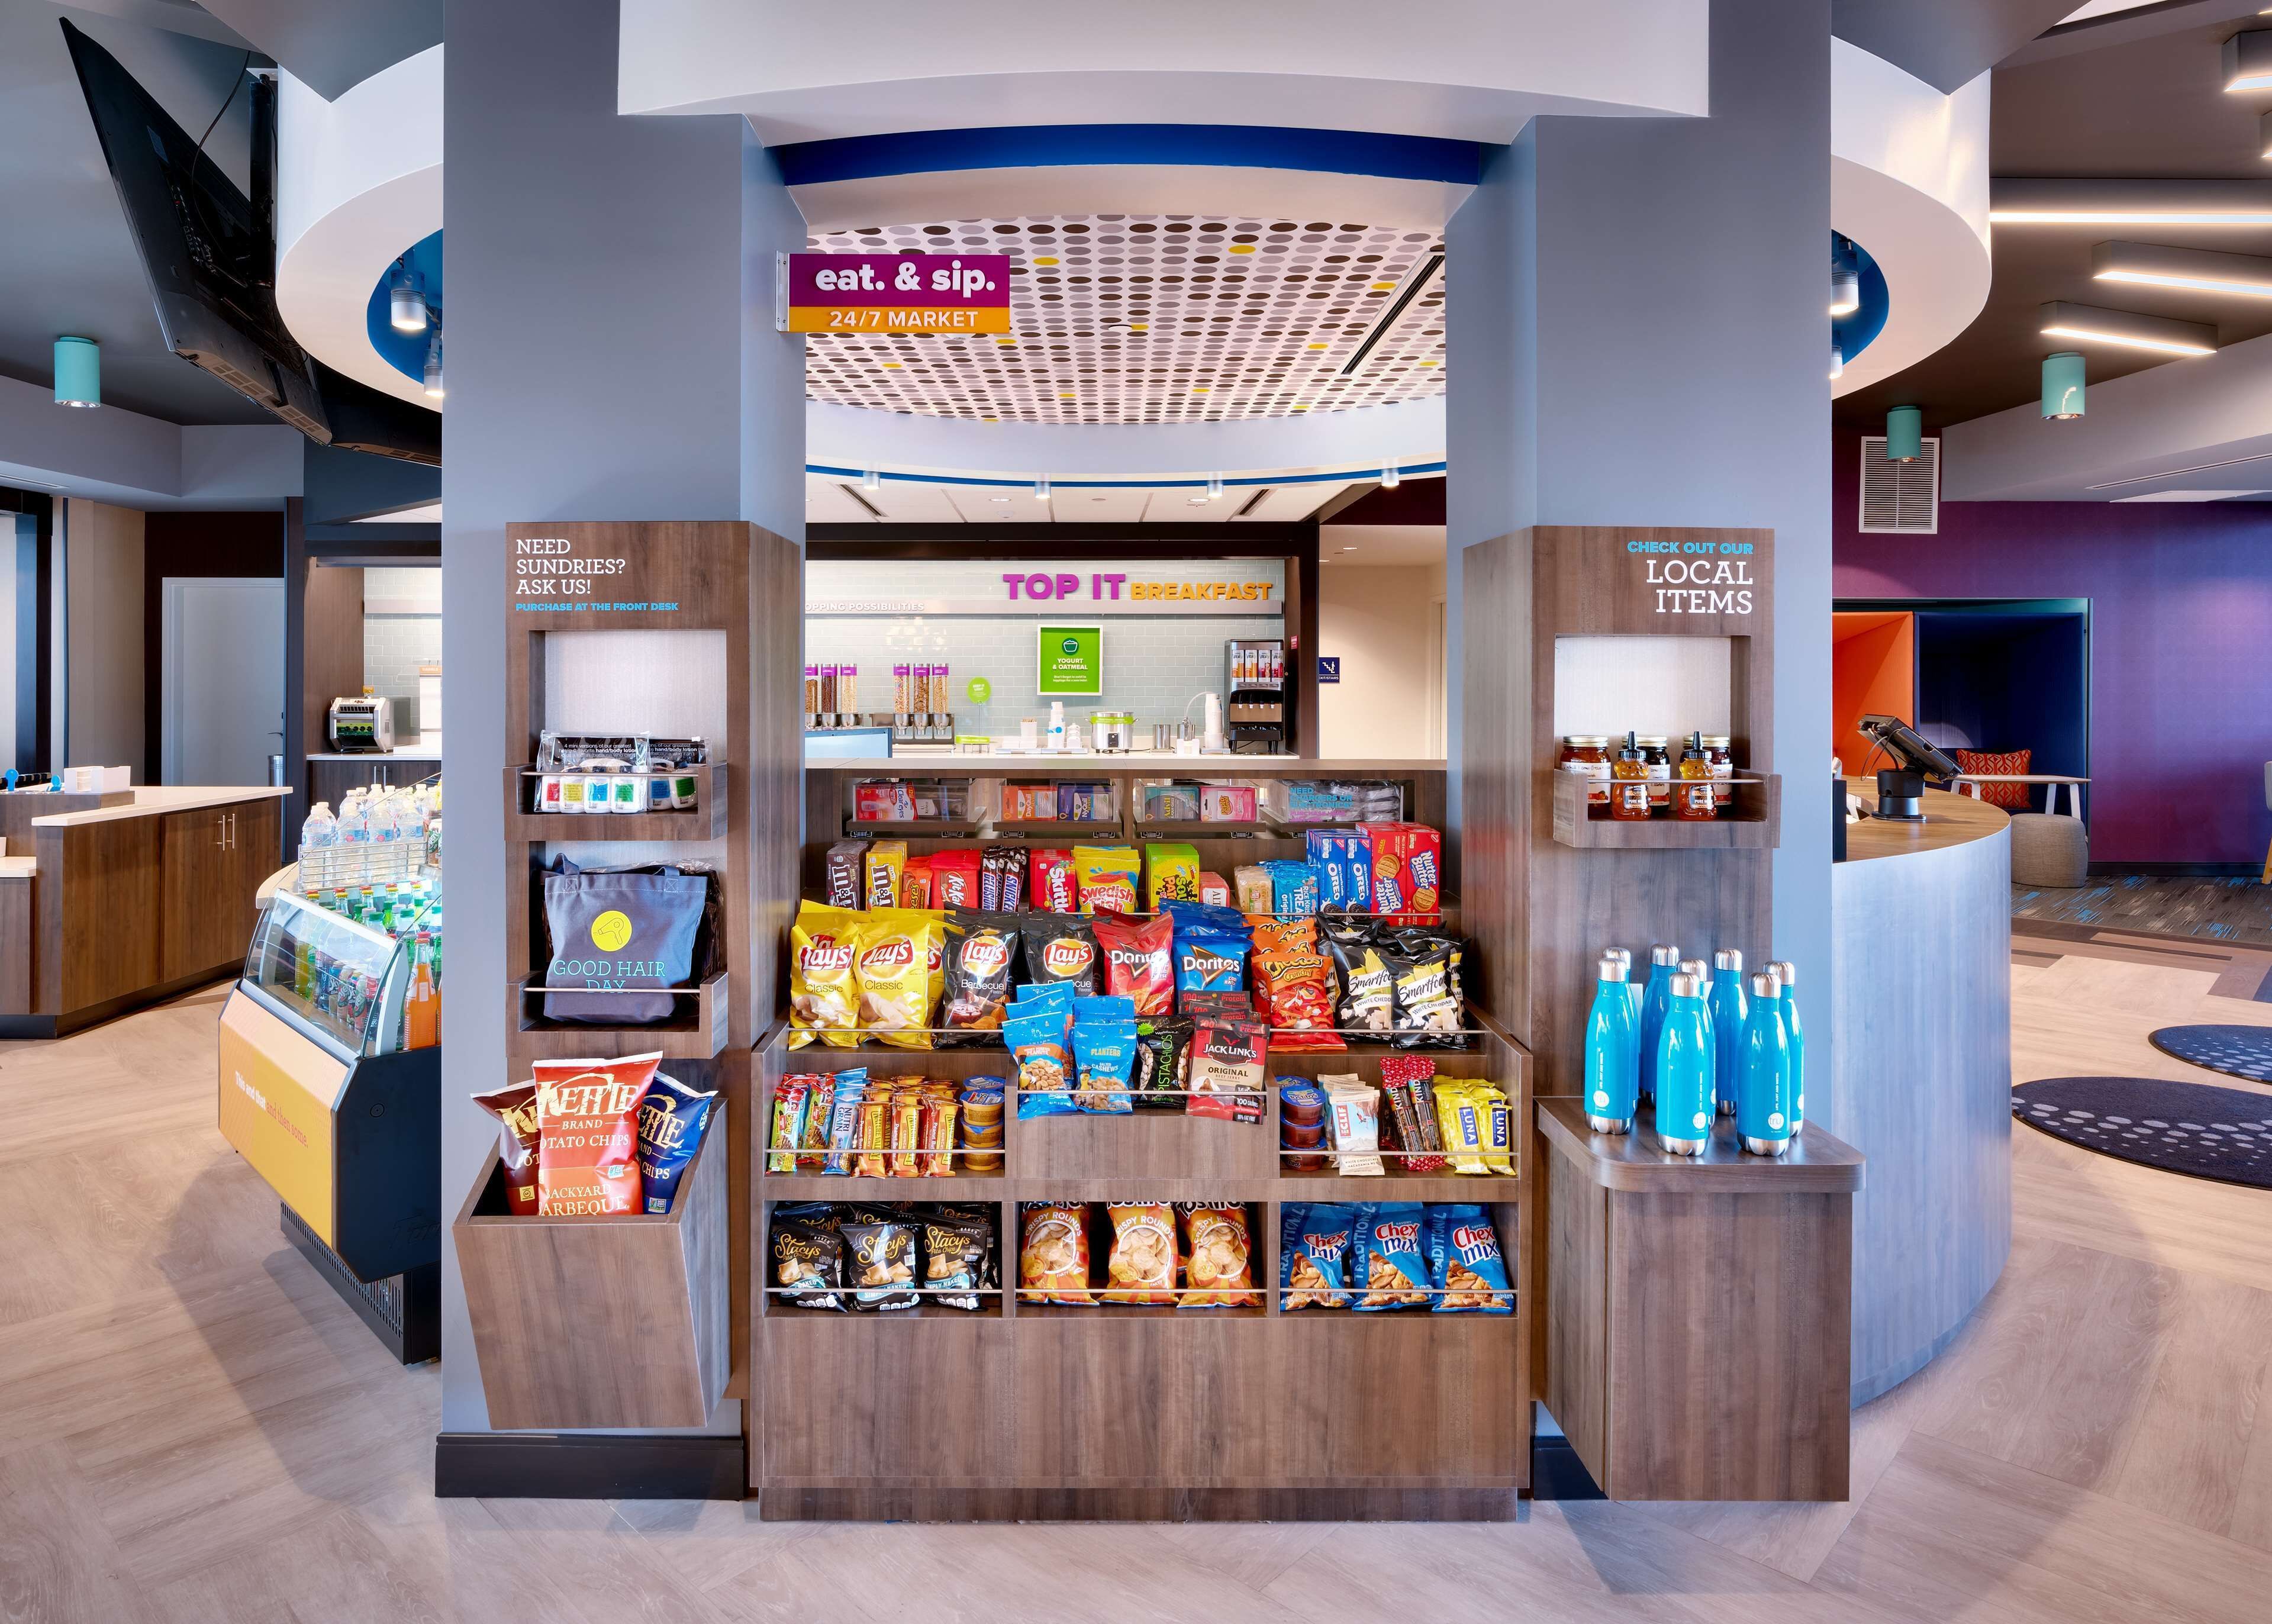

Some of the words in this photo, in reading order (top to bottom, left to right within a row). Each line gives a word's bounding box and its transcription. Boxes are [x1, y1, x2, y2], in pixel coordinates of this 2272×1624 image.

[816, 264, 885, 291] eat.
[894, 262, 921, 291] &
[932, 260, 995, 298] sip.
[830, 311, 881, 328] 24/7
[888, 311, 978, 328] MARKET
[516, 539, 571, 554] NEED
[1628, 542, 1680, 553] CHECK
[1684, 543, 1716, 554] OUT
[1720, 543, 1753, 555] OUR
[517, 559, 626, 575] SUNDRIES?
[1646, 560, 1753, 585] LOCAL
[515, 579, 556, 594] ASK
[562, 579, 591, 594] US!
[1003, 573, 1079, 600] TOP
[1093, 573, 1126, 600] IT
[1131, 582, 1274, 601] BREAKFAST
[613, 602, 648, 611] FRONT
[651, 602, 678, 611] DESK
[805, 603, 845, 611] OPPING
[849, 603, 924, 611] POSSIBILITIES
[1656, 589, 1752, 614] ITEMS
[1410, 856, 1430, 890] Butter
[1421, 850, 1437, 885] Nutter
[1049, 867, 1069, 913] Skittl
[1326, 862, 1340, 901] OREO
[1352, 862, 1365, 901] OREO
[1003, 875, 1017, 913] SNICKE
[1079, 885, 1135, 904] Swedish
[1375, 881, 1392, 914] Nutter
[1383, 877, 1403, 910] Butter
[804, 945, 853, 971] Lay's
[862, 940, 910, 966] Lay's
[965, 941, 1005, 967] Lay's
[1046, 943, 1090, 966] Lay's
[553, 960, 611, 976] GOOD
[617, 961, 666, 977] HAIR
[1183, 956, 1240, 973] Doritos
[1284, 969, 1312, 981] Crunchy
[805, 984, 843, 993] Classic
[865, 979, 903, 990] Classic
[1349, 968, 1391, 994] Smartfo
[1398, 974, 1445, 1003] Smartfoo
[1356, 998, 1373, 1007] WHITE
[1412, 1005, 1427, 1015] WHITE
[1427, 1000, 1452, 1009] CHEDDAR
[1091, 1049, 1120, 1057] PLANTERS
[1203, 1043, 1227, 1054] JACK
[1229, 1046, 1257, 1058] LINK'S
[1092, 1064, 1119, 1072] CASHEWS
[1208, 1066, 1248, 1077] ORIGINAL
[537, 1072, 640, 1118] KETTLE
[1392, 1087, 1402, 1109] KIND
[1413, 1080, 1424, 1102] KIND
[236, 1071, 245, 1091] This
[246, 1084, 255, 1100] and
[255, 1090, 266, 1111] that
[266, 1102, 277, 1120] and
[278, 1106, 290, 1132] then
[292, 1124, 308, 1148] some.
[836, 1107, 844, 1131] GRAIN
[843, 1108, 852, 1132] NUTRI
[1338, 1107, 1349, 1129] CLIF
[561, 1119, 603, 1130] BRAND
[638, 1094, 686, 1149] ETTLE
[1462, 1109, 1476, 1142] LUNA
[1496, 1111, 1505, 1143] LUNA
[540, 1135, 585, 1149] OTATO
[595, 1134, 630, 1147] CHIPS
[871, 1136, 881, 1158] VALLY
[642, 1162, 670, 1180] CHIPS
[544, 1184, 611, 1199] BACKYARD
[1026, 1212, 1049, 1236] CRISPY
[1052, 1211, 1082, 1236] ROUNDS
[1117, 1216, 1137, 1238] RISPY
[1140, 1216, 1174, 1240] ROUNDS
[1194, 1217, 1213, 1244] CRISPY
[1216, 1216, 1247, 1240] ROUNDS
[1375, 1222, 1420, 1240] Chex
[775, 1233, 821, 1259] Stacy's
[924, 1226, 971, 1254] Stacy's
[1304, 1231, 1349, 1248] Chex
[1383, 1237, 1419, 1256] mix
[1453, 1225, 1496, 1249] Chex
[858, 1235, 907, 1263] Stacy's
[1310, 1242, 1347, 1262] mix
[1462, 1240, 1501, 1267] mix
[944, 1277, 962, 1287] NAKED
